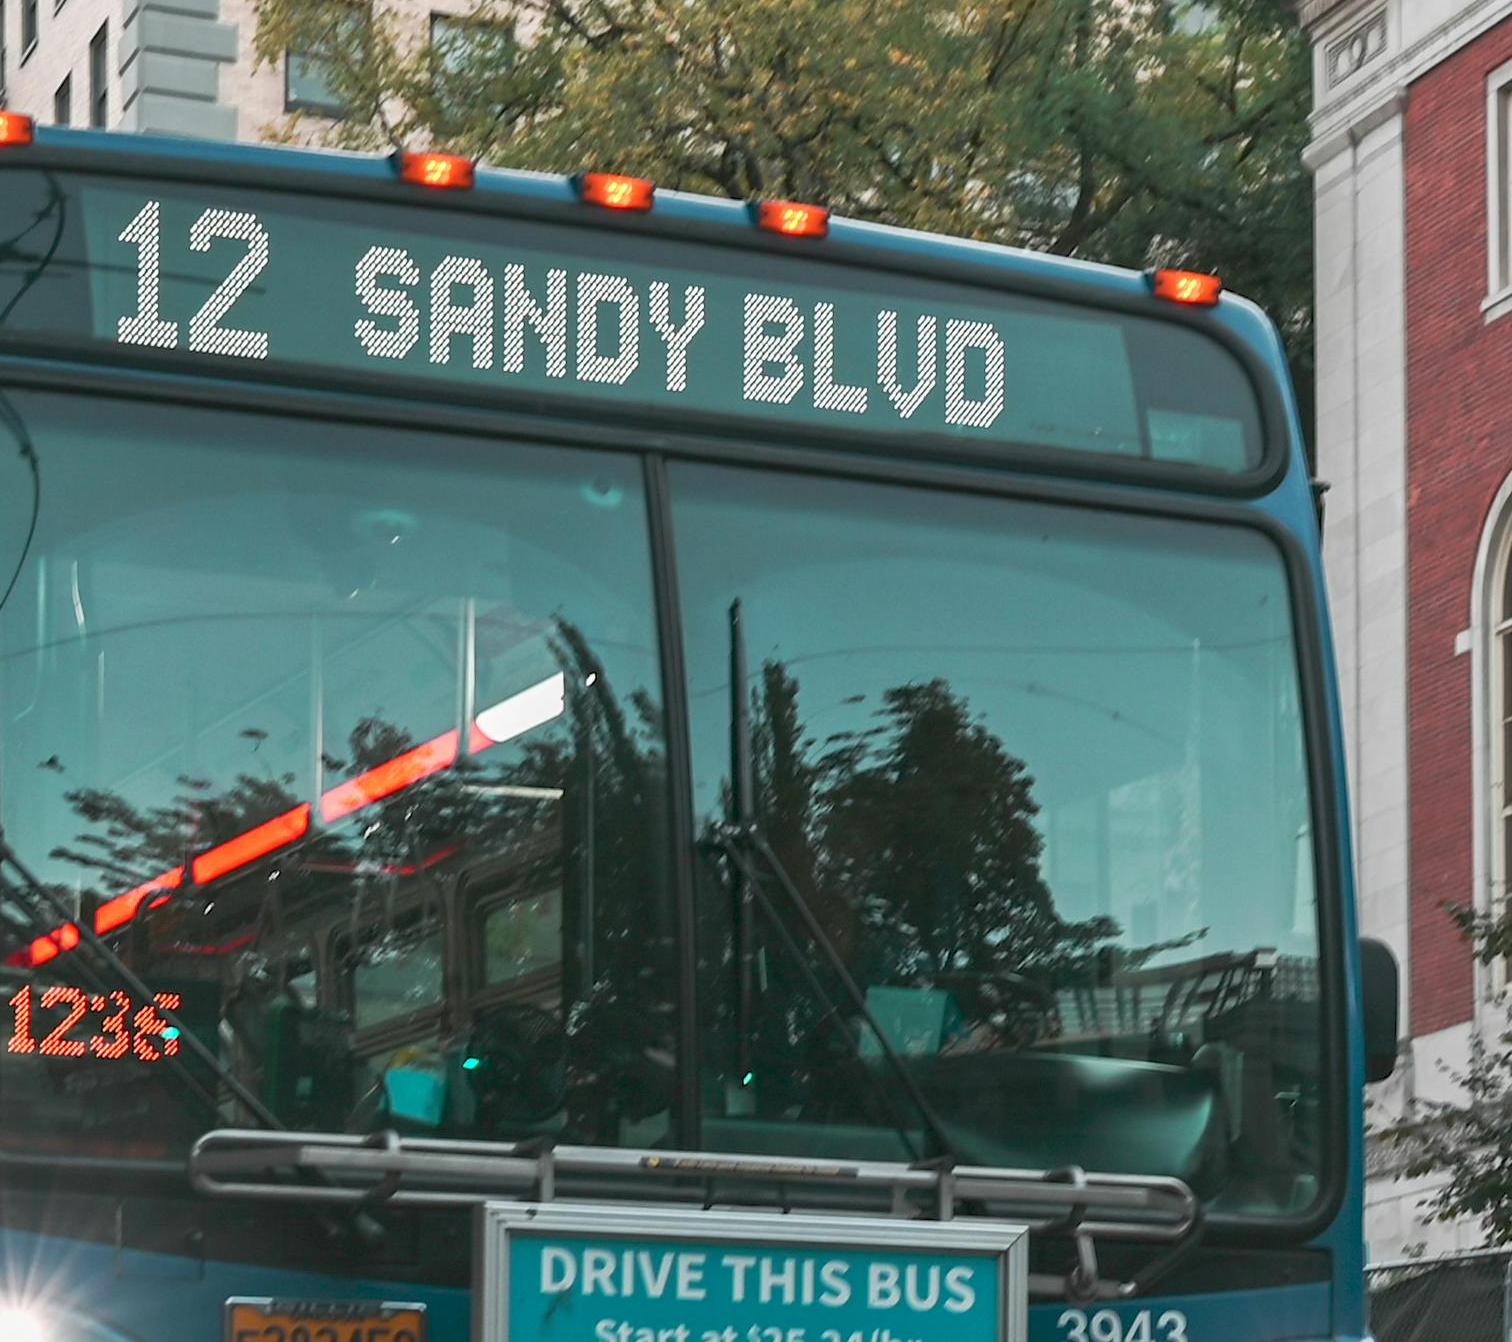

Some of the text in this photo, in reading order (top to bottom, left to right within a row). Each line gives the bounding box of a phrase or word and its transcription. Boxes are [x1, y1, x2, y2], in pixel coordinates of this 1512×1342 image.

[116, 200, 1006, 430] 12 SANDY BLVD
[539, 1246, 977, 1314] DRIVE THIS BUS
